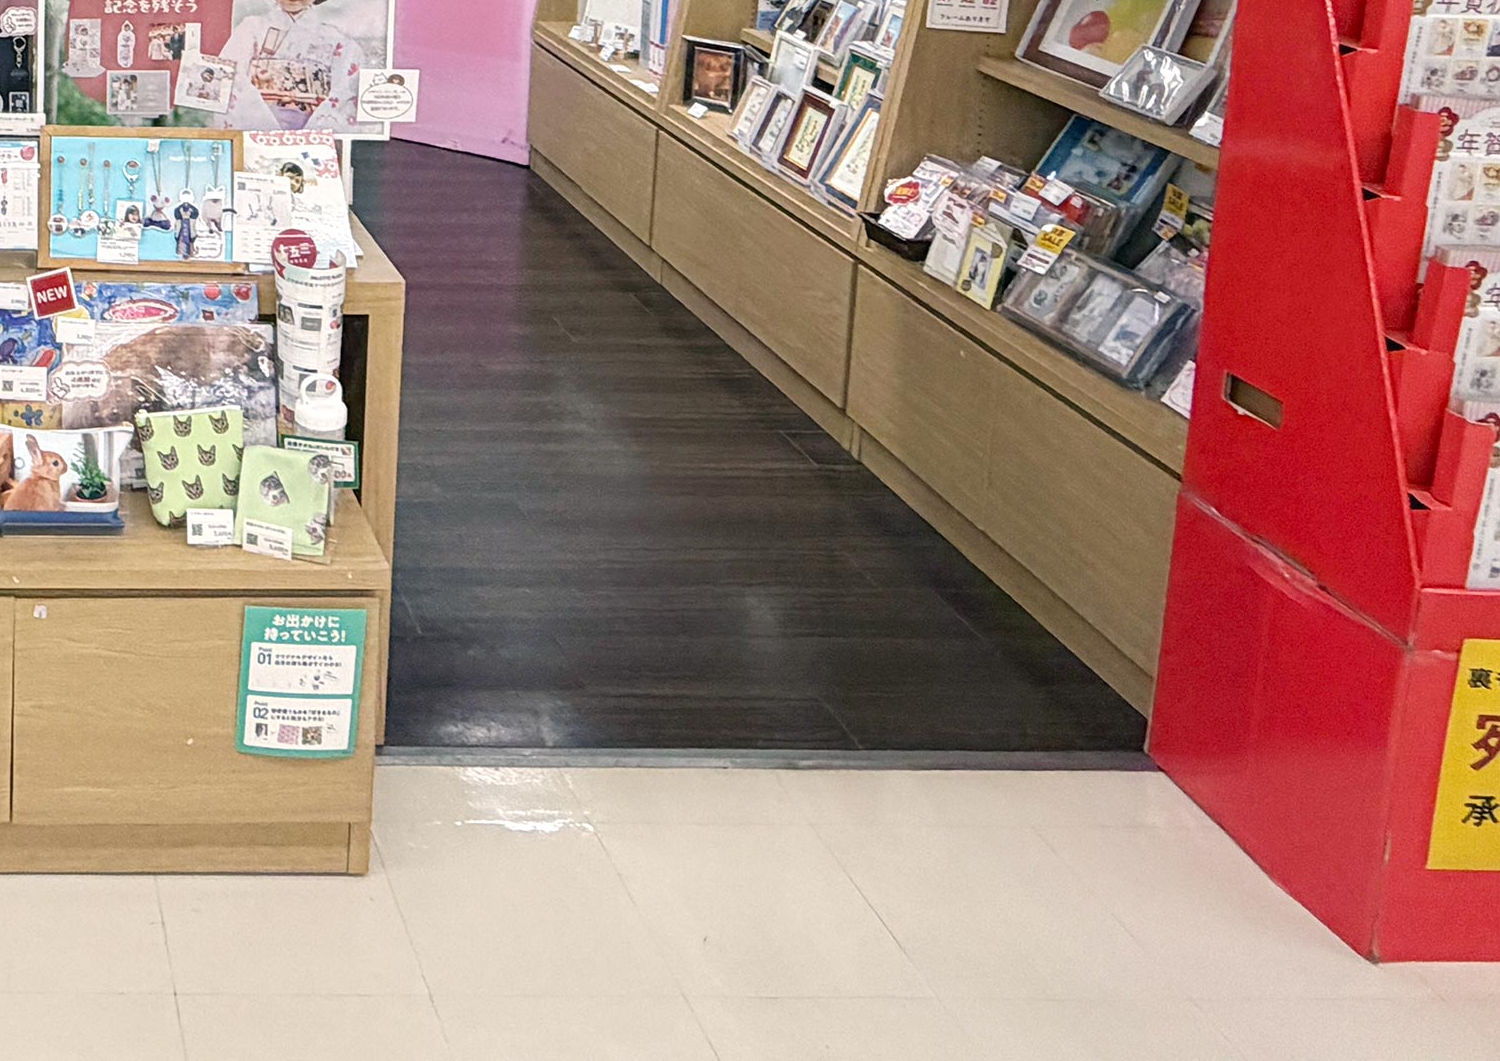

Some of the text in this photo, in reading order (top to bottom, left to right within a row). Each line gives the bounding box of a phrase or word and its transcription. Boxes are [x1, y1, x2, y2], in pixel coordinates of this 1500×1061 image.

[35, 284, 69, 305] NEW
[272, 614, 341, 629] お出かけに
[263, 627, 347, 644] 持っていこう!
[257, 652, 273, 666] 01
[252, 706, 269, 720] 02
